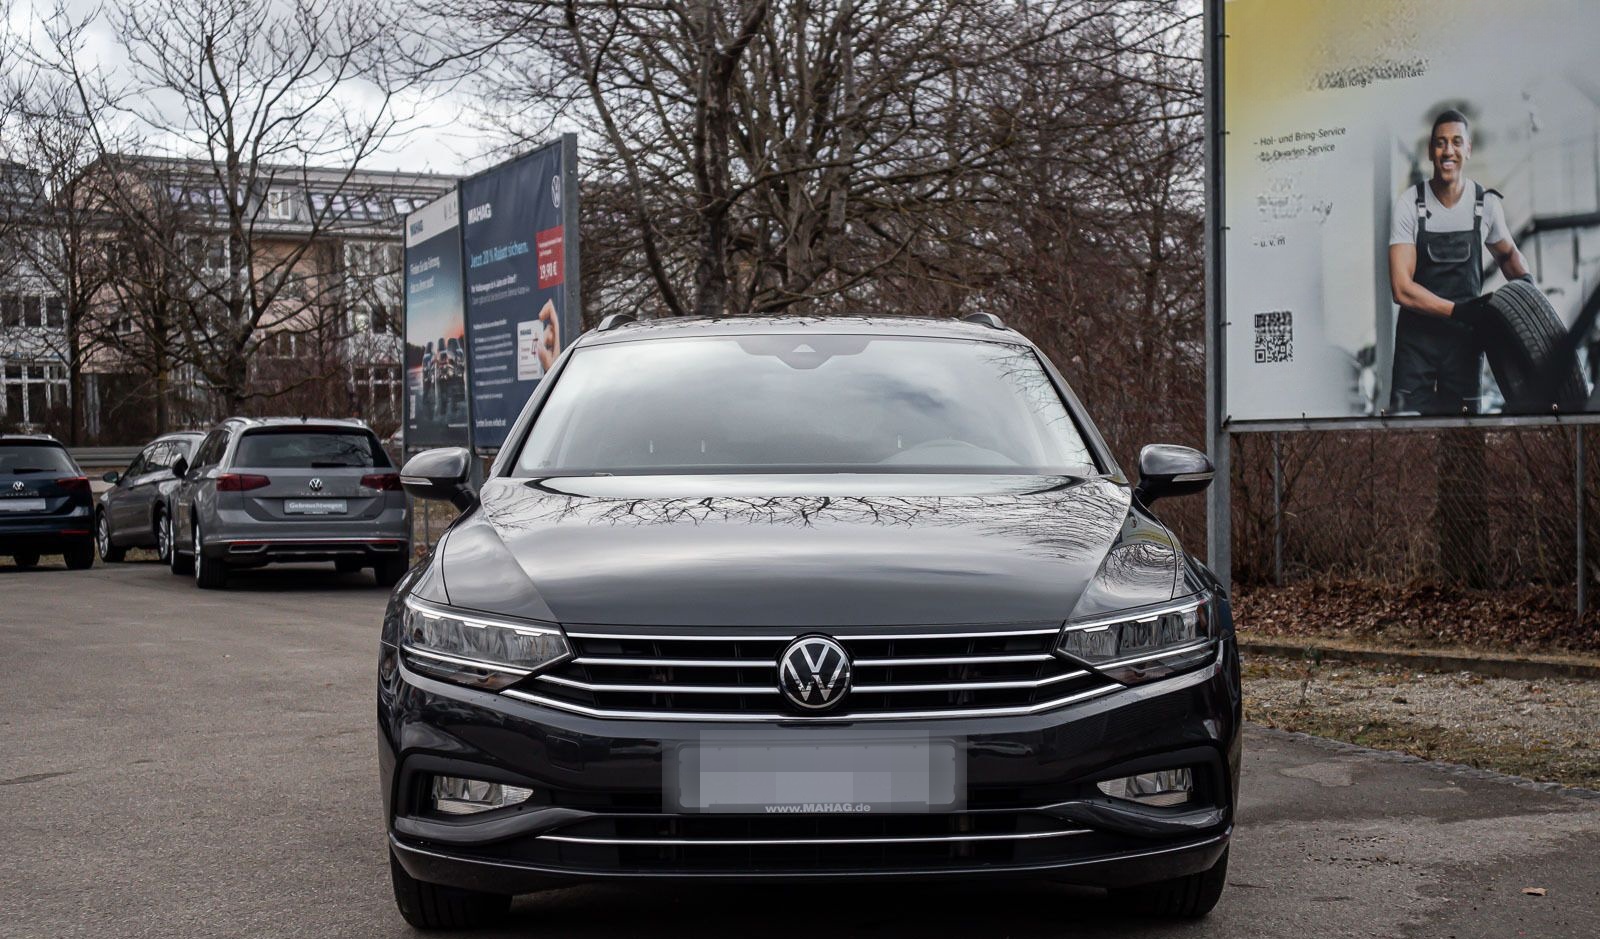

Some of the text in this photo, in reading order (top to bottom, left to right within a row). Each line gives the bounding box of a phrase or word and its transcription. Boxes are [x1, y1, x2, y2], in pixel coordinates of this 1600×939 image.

[1278, 134, 1293, 143] und
[1295, 127, 1346, 141] Bring-Service
[468, 203, 492, 224] MAHAG
[765, 803, 871, 813] www.MAHAG.de
